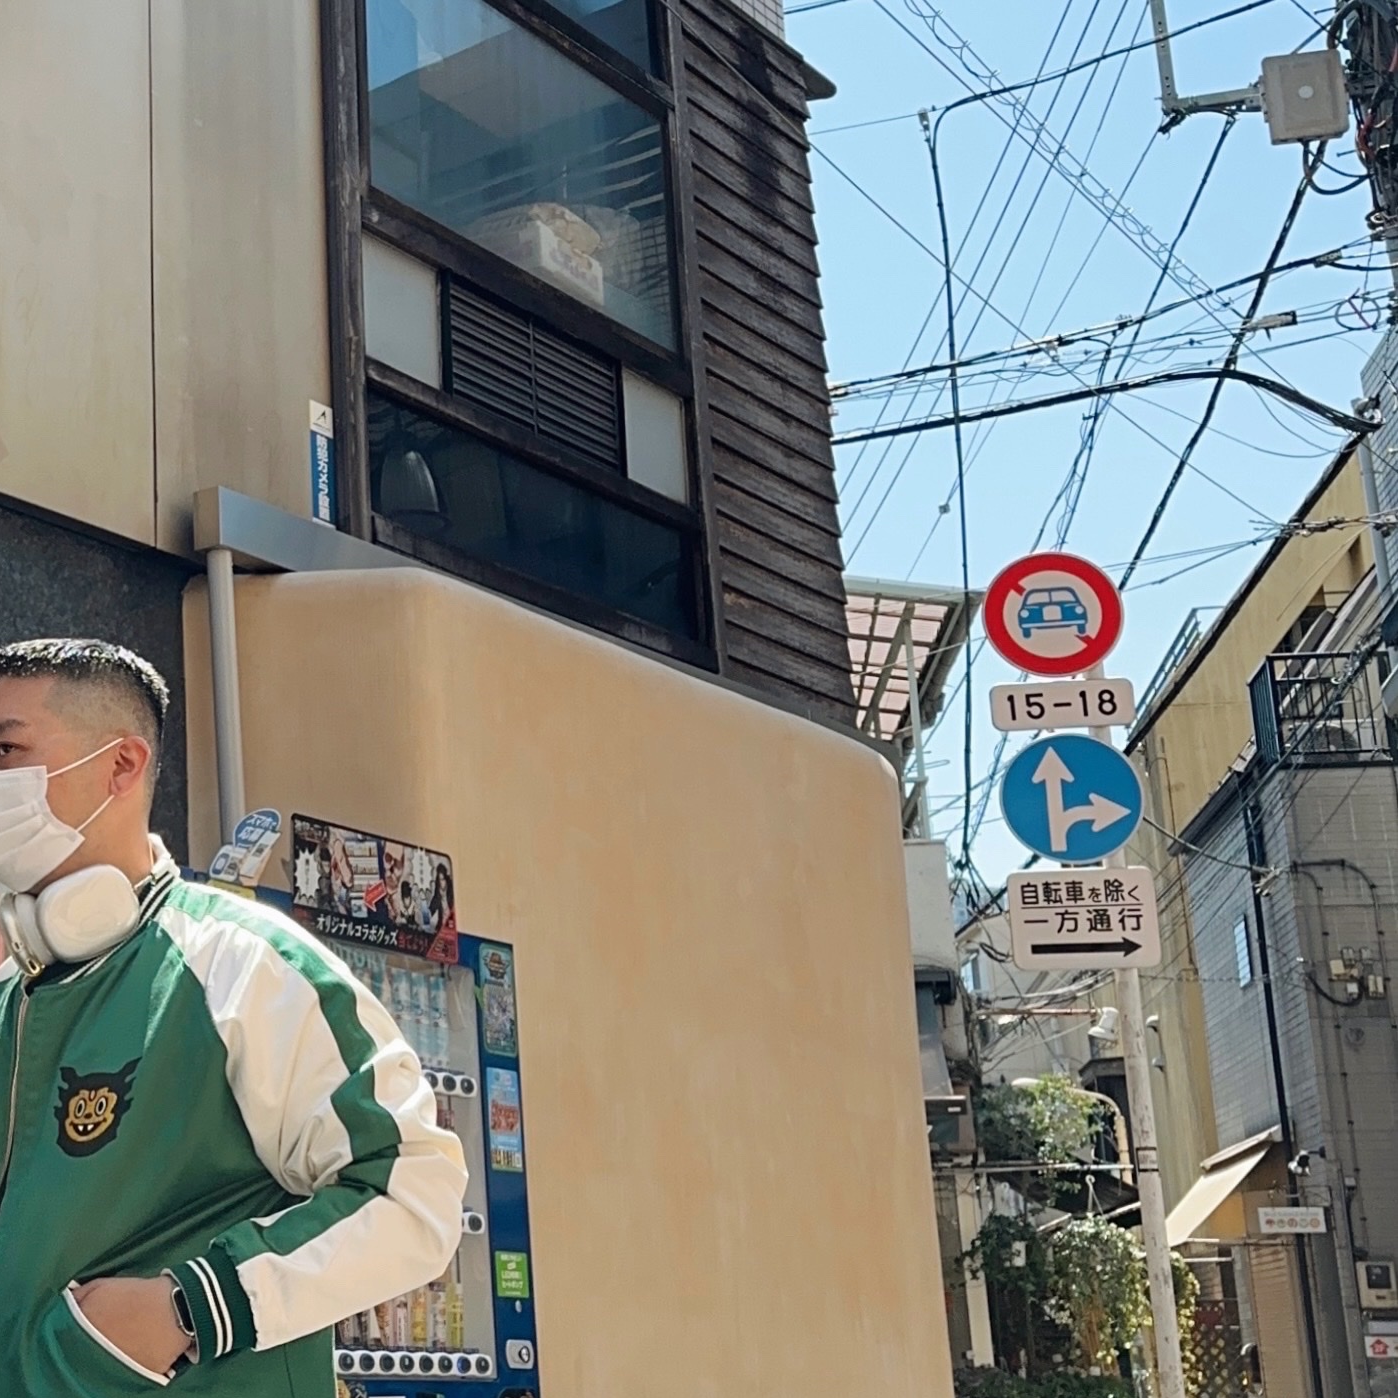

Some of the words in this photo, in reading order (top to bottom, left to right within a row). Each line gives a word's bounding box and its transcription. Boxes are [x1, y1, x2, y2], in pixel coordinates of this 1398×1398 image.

[1005, 688, 1118, 722] 15-18
[1020, 878, 1141, 907] 自転車を除く
[316, 913, 399, 946] オリジナルコラボグッズ
[1023, 907, 1144, 934] 一方通行
